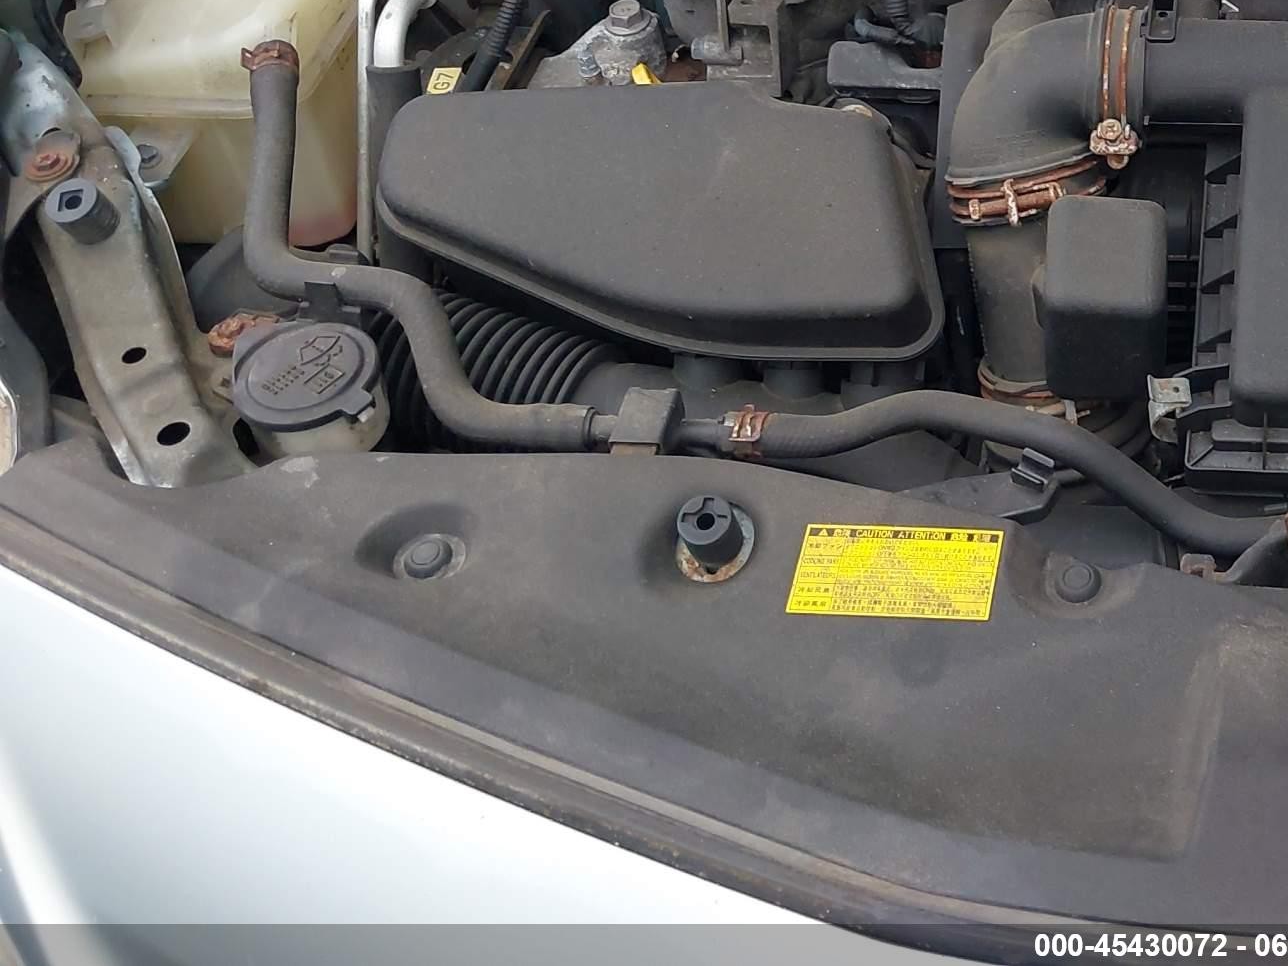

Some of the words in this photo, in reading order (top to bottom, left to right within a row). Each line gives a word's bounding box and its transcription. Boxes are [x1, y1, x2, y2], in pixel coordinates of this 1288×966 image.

[433, 73, 454, 90] G7
[856, 529, 893, 538] CAUTION
[898, 530, 945, 540] ATTENTION
